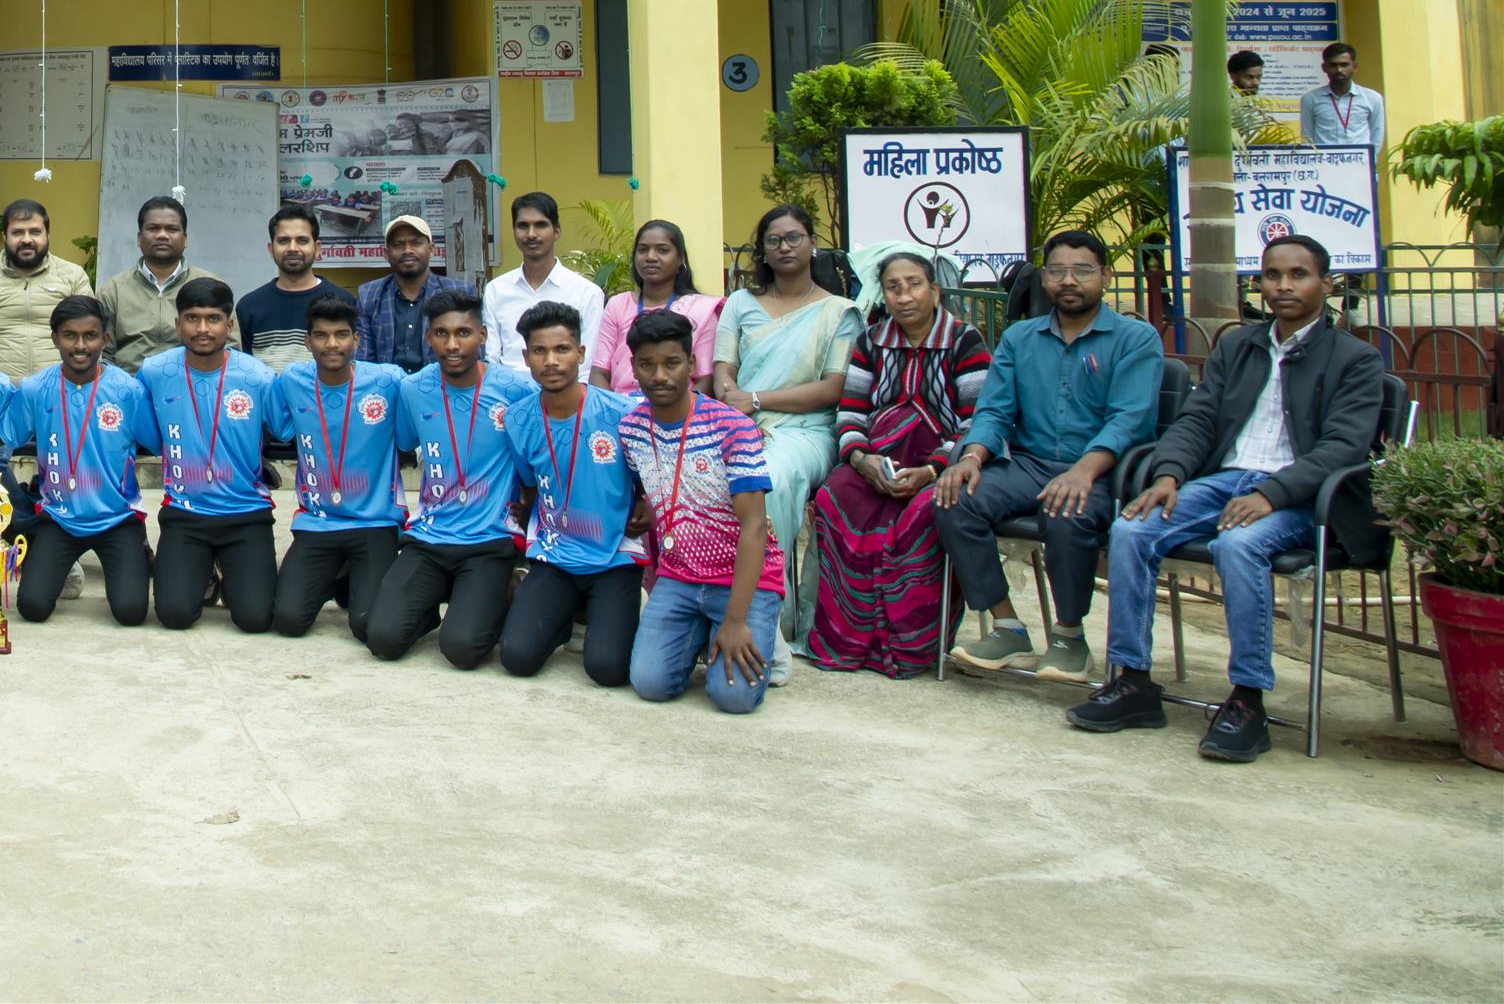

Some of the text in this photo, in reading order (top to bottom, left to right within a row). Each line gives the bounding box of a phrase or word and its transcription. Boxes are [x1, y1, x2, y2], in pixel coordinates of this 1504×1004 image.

[1233, 5, 1326, 19] 2024 से जून 2025
[111, 52, 144, 67] महाविद्यालय
[146, 52, 165, 66] परिसर
[175, 52, 200, 66] प्लास्टिक
[202, 54, 210, 65] का
[213, 51, 233, 65] उपयोग
[252, 51, 269, 66] वर्जित
[728, 61, 747, 84] 3
[294, 124, 333, 139] प्रेमजी
[280, 138, 330, 154] लरशिप
[863, 138, 1003, 179] महिला प्रकोष्ठ
[1250, 183, 1295, 211] सेवा
[1300, 184, 1371, 227] योजना
[1346, 252, 1371, 264] विकास
